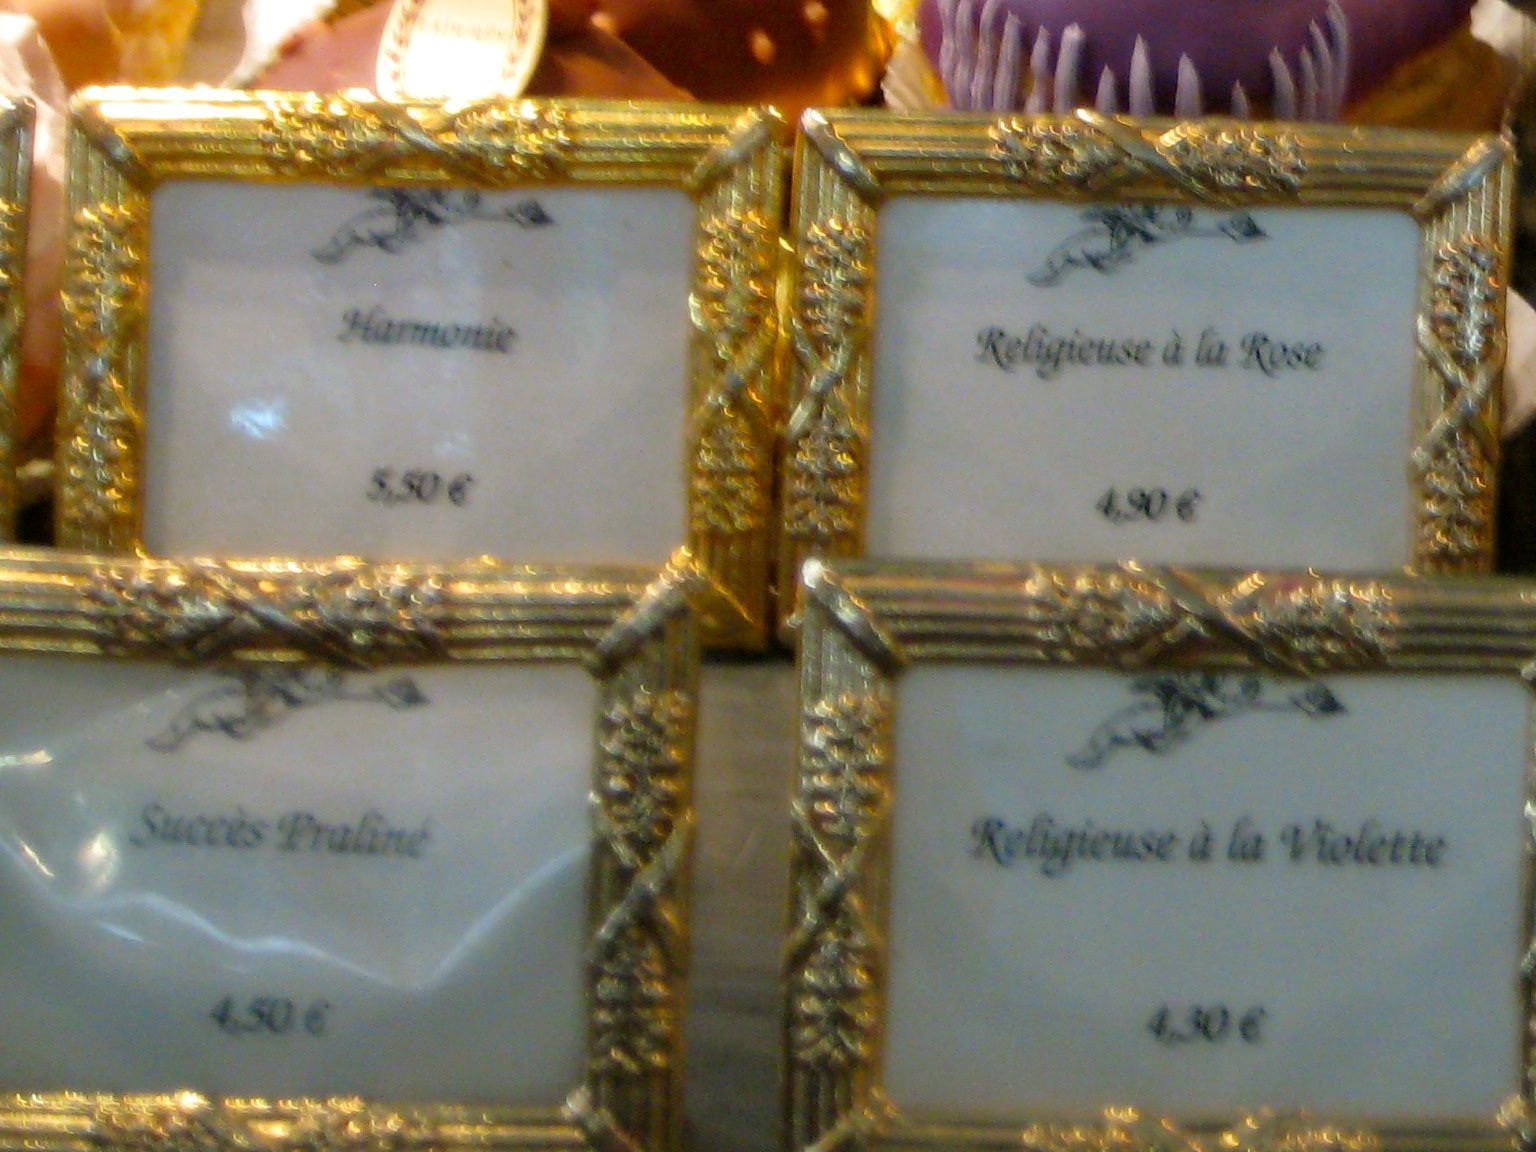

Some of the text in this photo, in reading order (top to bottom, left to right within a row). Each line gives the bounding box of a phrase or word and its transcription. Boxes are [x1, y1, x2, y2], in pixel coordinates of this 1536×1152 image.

[339, 304, 516, 354] Harmonie
[976, 322, 1325, 380] Religieuse à la Rose
[131, 803, 264, 850] Succès
[970, 810, 1446, 879] Religieuse à la Violette
